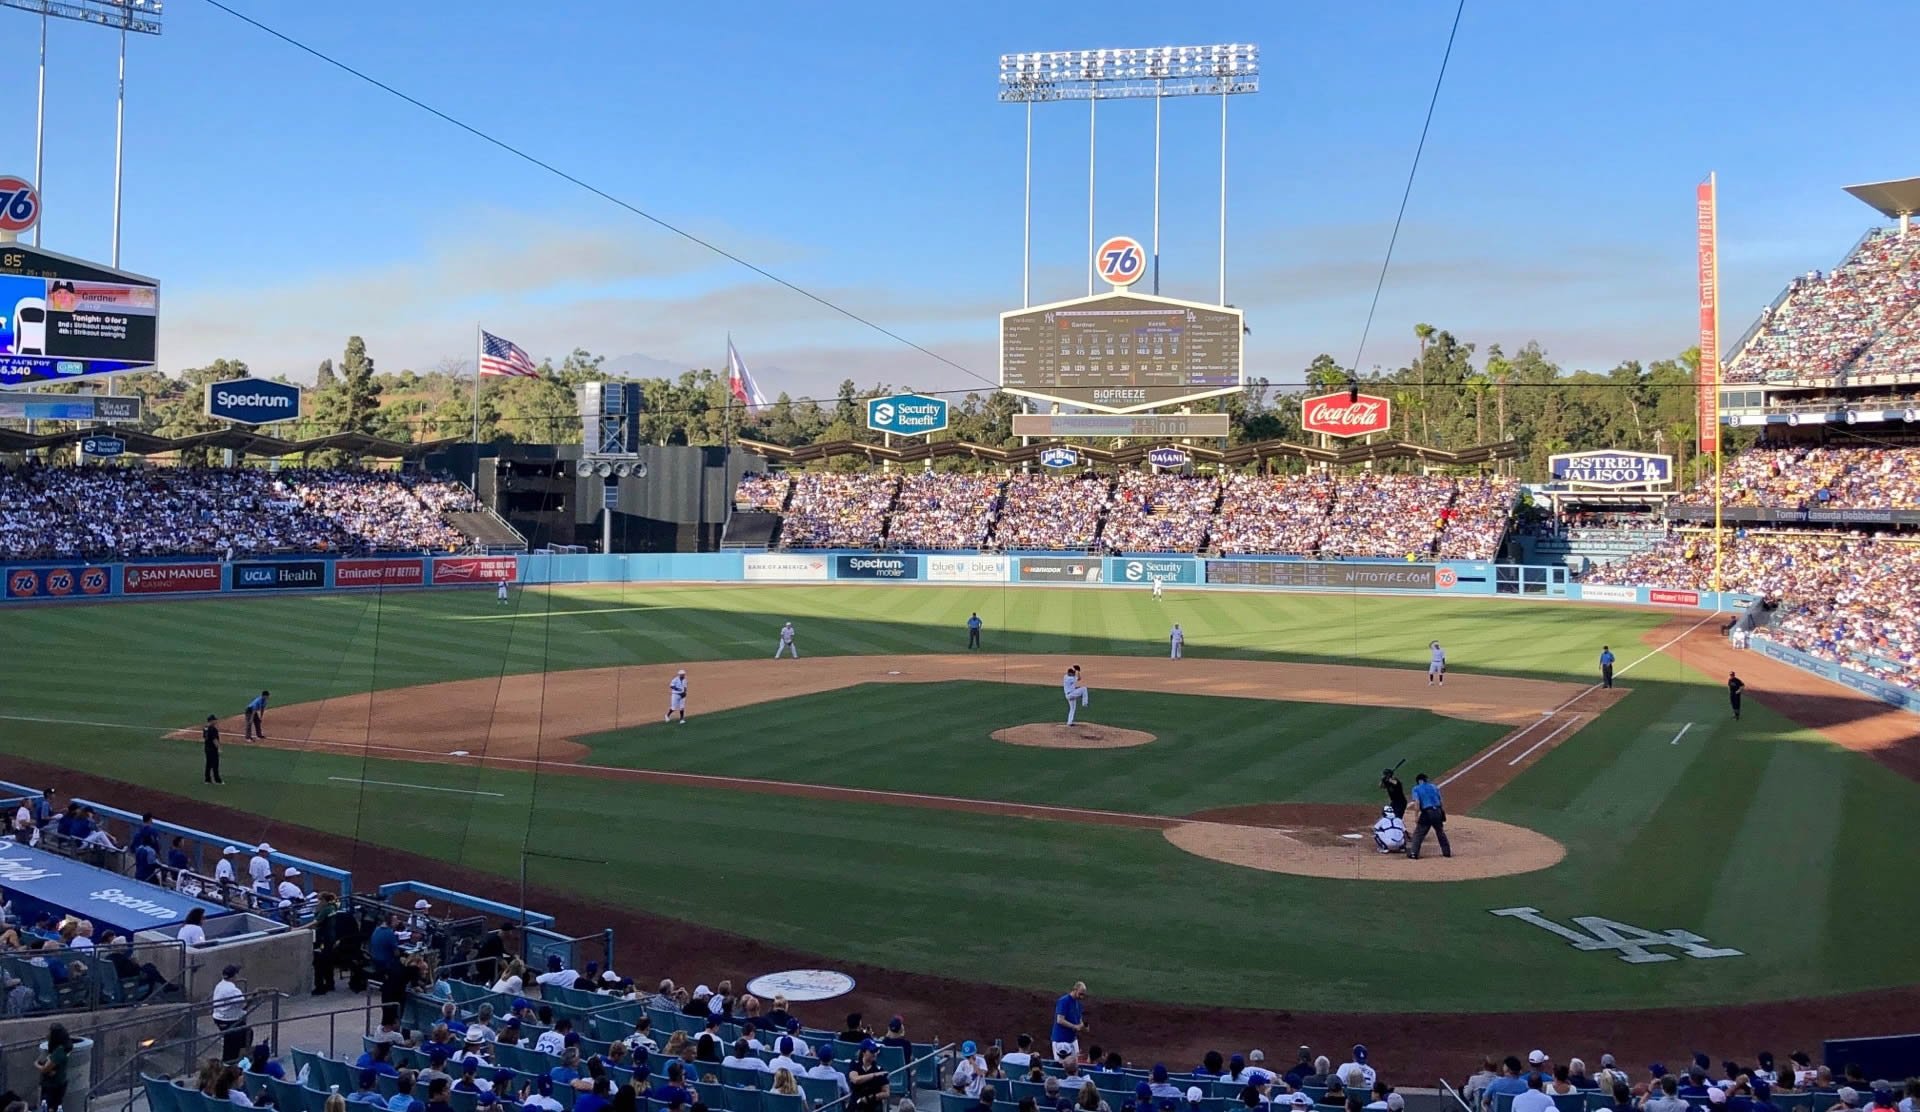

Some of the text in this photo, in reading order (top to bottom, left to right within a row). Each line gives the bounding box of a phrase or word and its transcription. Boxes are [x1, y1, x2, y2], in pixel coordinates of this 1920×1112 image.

[1105, 248, 1138, 274] 76
[1700, 251, 1713, 309] Emirates
[82, 293, 117, 302] Gardner
[72, 314, 101, 324] Tonight:
[1792, 376, 1877, 387] DODGER
[217, 392, 290, 408] Spectrum
[898, 404, 941, 417] Security
[1309, 402, 1381, 426] Coca-Cola
[1703, 382, 1715, 439] Emirates
[898, 415, 934, 425] Benefit
[1151, 453, 1183, 463] DASANI
[1563, 469, 1638, 481] JALISCO
[1775, 509, 1807, 521] Tommy
[1808, 510, 1841, 520] Lasorda
[1842, 511, 1891, 521] Bobblehead
[496, 561, 516, 569] BUD'S
[850, 558, 901, 571] Spectrum
[932, 561, 954, 571] blue
[972, 562, 994, 572] blue
[1146, 561, 1181, 573] Security
[142, 568, 217, 580] SAN MANUEL
[244, 569, 317, 581] UCLA Health
[339, 567, 421, 579] Emirates FLY BETTER
[480, 570, 493, 578] FOR
[876, 569, 900, 577] mobile
[1345, 570, 1430, 584] NITTOTIRE.COM
[1440, 573, 1452, 583] 76
[15, 574, 104, 590] 76 76 76
[90, 888, 178, 919] Spectrum
[1489, 906, 1746, 963] LA
